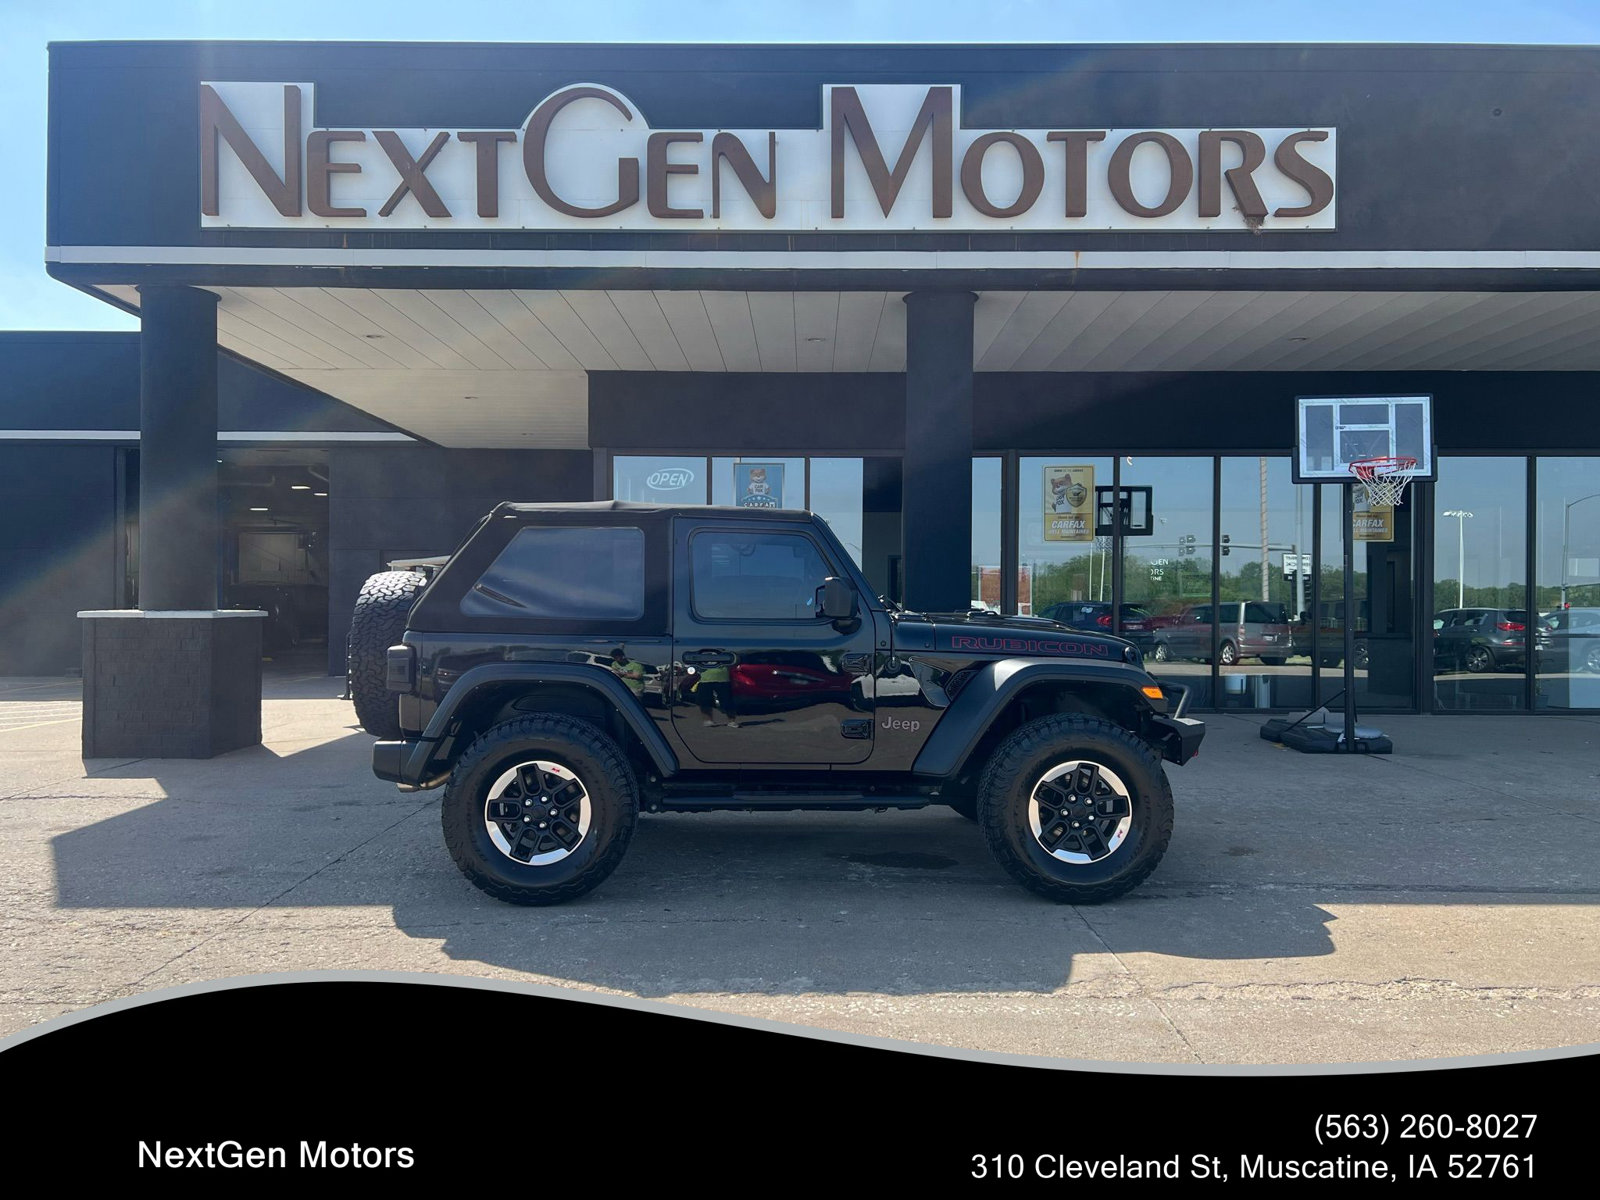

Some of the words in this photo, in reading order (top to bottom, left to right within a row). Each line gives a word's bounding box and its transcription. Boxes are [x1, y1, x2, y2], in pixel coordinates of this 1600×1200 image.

[201, 84, 776, 219] NEXTGEN
[831, 86, 1334, 219] MOTORS
[650, 472, 689, 487] OPEN
[1051, 520, 1086, 529] CARFAX
[952, 636, 1109, 657] RUBICON
[881, 716, 921, 733] Jeep
